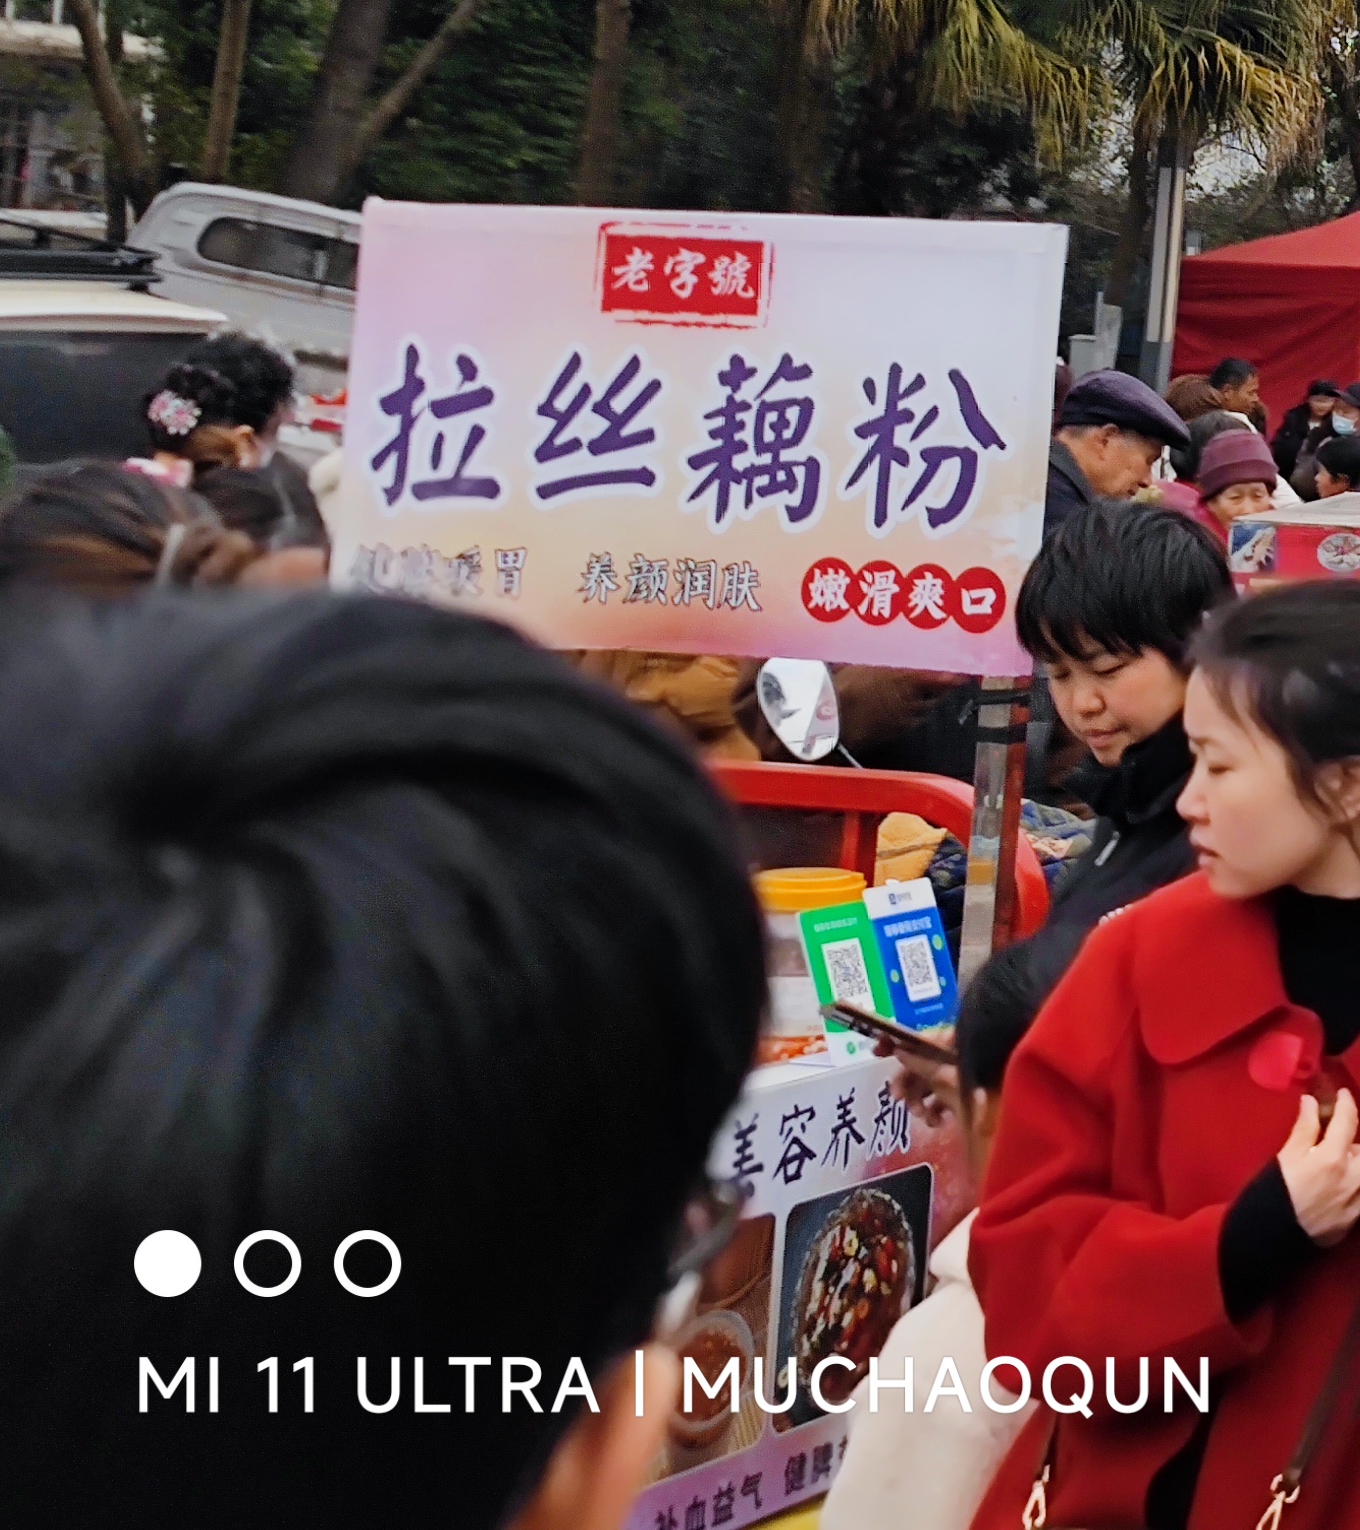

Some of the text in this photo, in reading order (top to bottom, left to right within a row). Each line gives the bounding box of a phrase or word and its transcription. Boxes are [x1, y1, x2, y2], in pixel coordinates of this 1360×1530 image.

[611, 247, 756, 300] 老字號
[370, 342, 1007, 530] 拉丝藕粉
[576, 551, 763, 612] 养颜润肤
[809, 564, 997, 622] 嫩滑爽口
